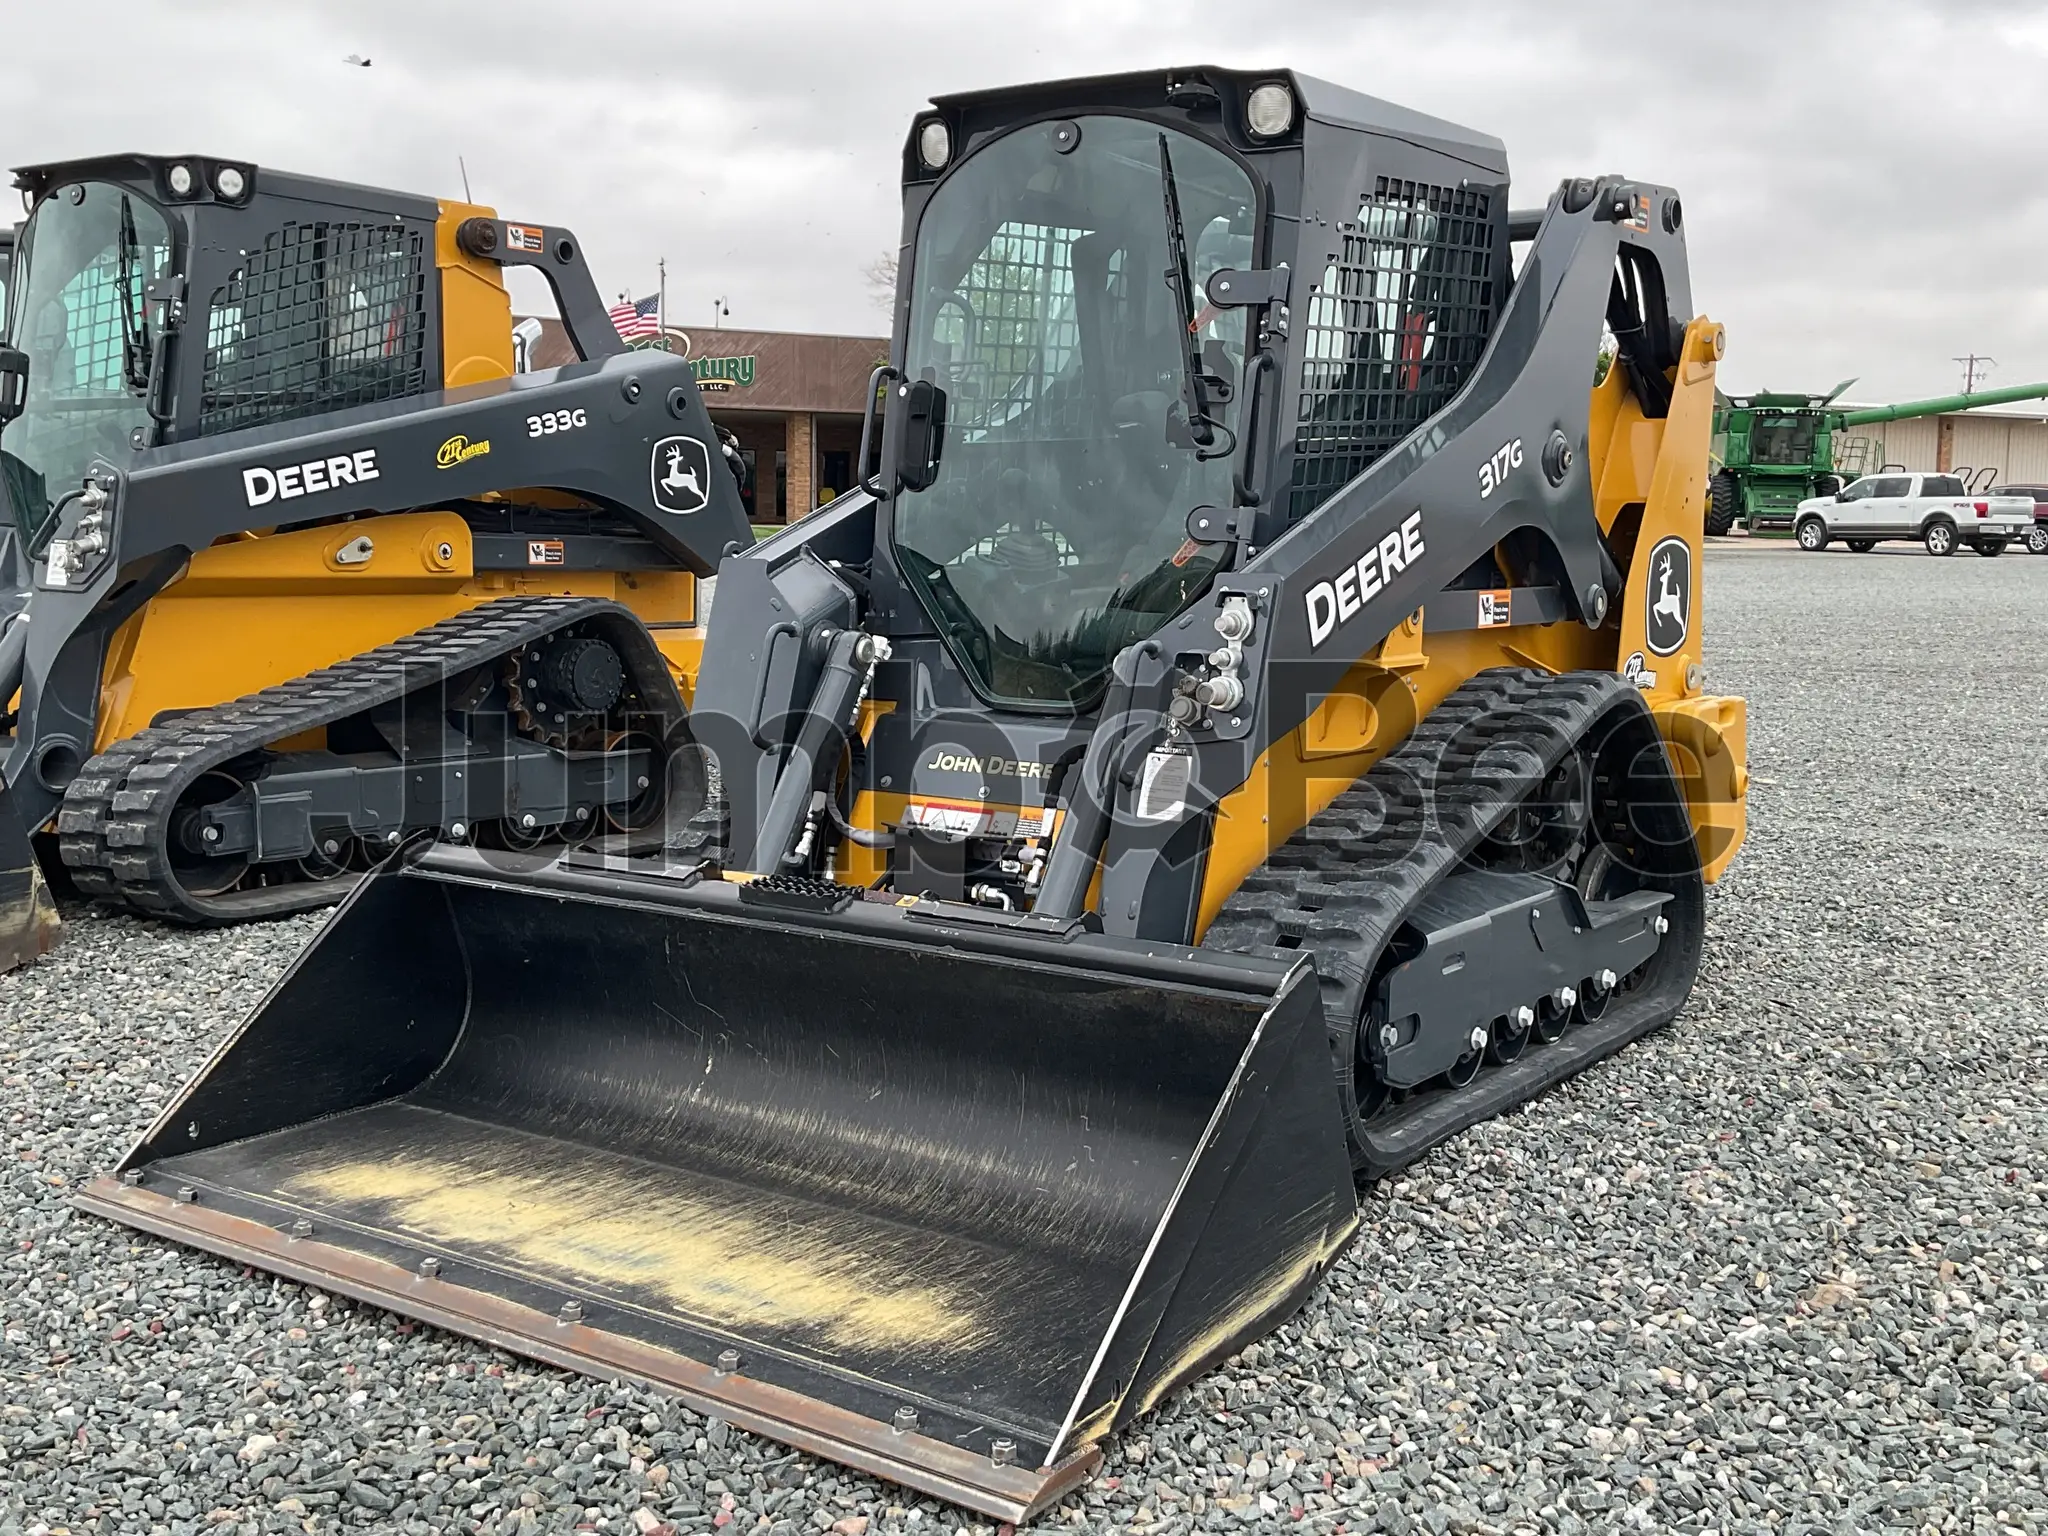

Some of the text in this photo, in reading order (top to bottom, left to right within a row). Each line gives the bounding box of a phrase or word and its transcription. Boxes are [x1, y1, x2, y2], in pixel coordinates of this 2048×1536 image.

[526, 408, 587, 438] 333G
[443, 438, 463, 463] 21st
[242, 449, 380, 507] DEERE
[1478, 438, 1523, 499] 317G
[1305, 509, 1426, 648] DEERE
[928, 751, 1054, 780] JOHN DEERE
[1154, 746, 1187, 755] IMPORTANT
